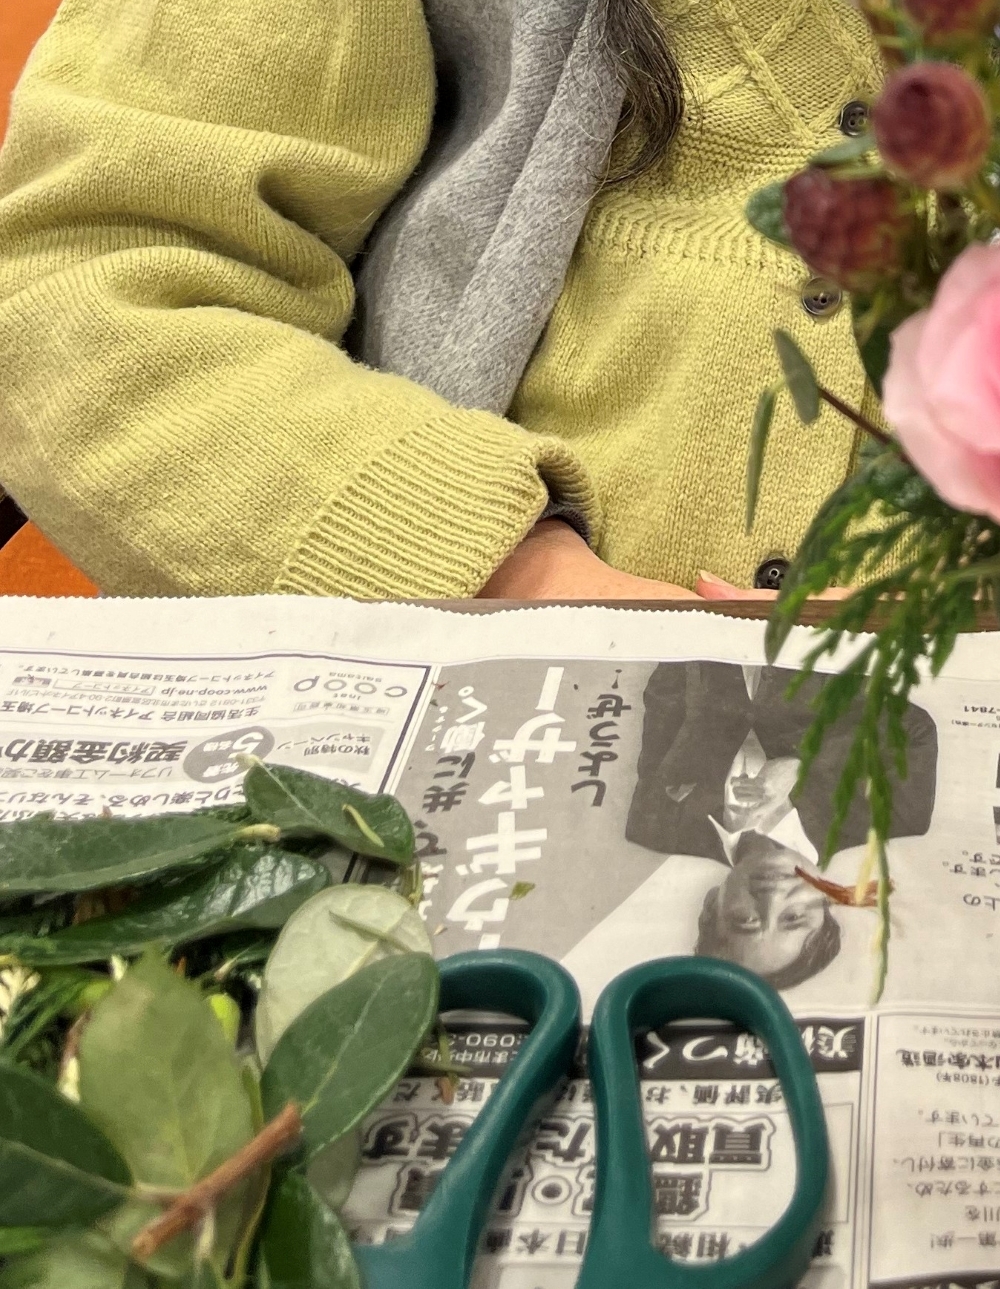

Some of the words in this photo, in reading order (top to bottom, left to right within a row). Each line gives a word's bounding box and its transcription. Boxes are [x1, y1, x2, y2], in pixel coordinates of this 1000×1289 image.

[161, 705, 260, 721] 生活協同組合
